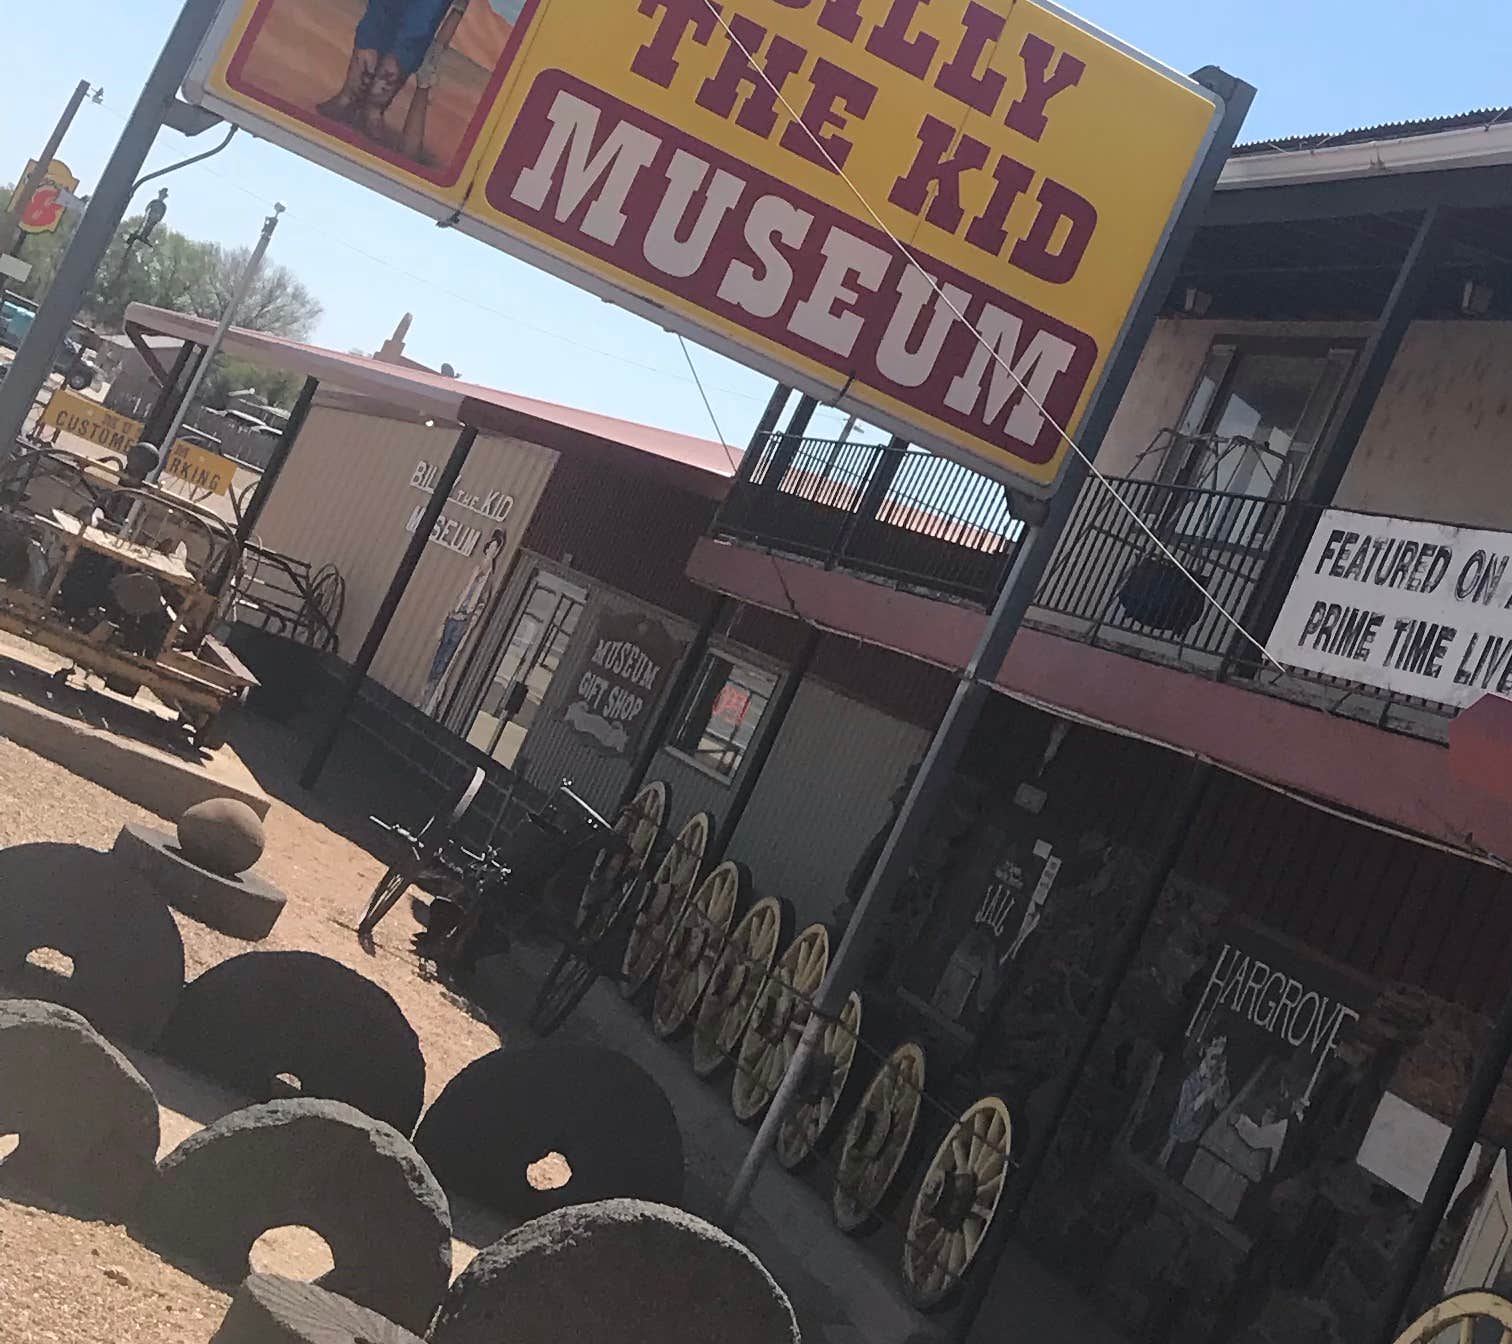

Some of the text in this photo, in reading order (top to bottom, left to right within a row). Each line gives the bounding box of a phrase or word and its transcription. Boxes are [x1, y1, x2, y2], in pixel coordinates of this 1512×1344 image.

[887, 111, 1101, 287] KID
[510, 83, 1076, 447] MUSEUM
[55, 410, 222, 490] CUSTOME RKING
[405, 505, 482, 556] MSEUM
[480, 488, 514, 522] KID
[1314, 528, 1454, 595] FEATURED
[1454, 549, 1510, 606] ON
[591, 639, 661, 690] MUSEUM
[1297, 600, 1386, 662] PRIME
[1383, 616, 1458, 679] TIME
[578, 671, 644, 721] GIFT SHOP
